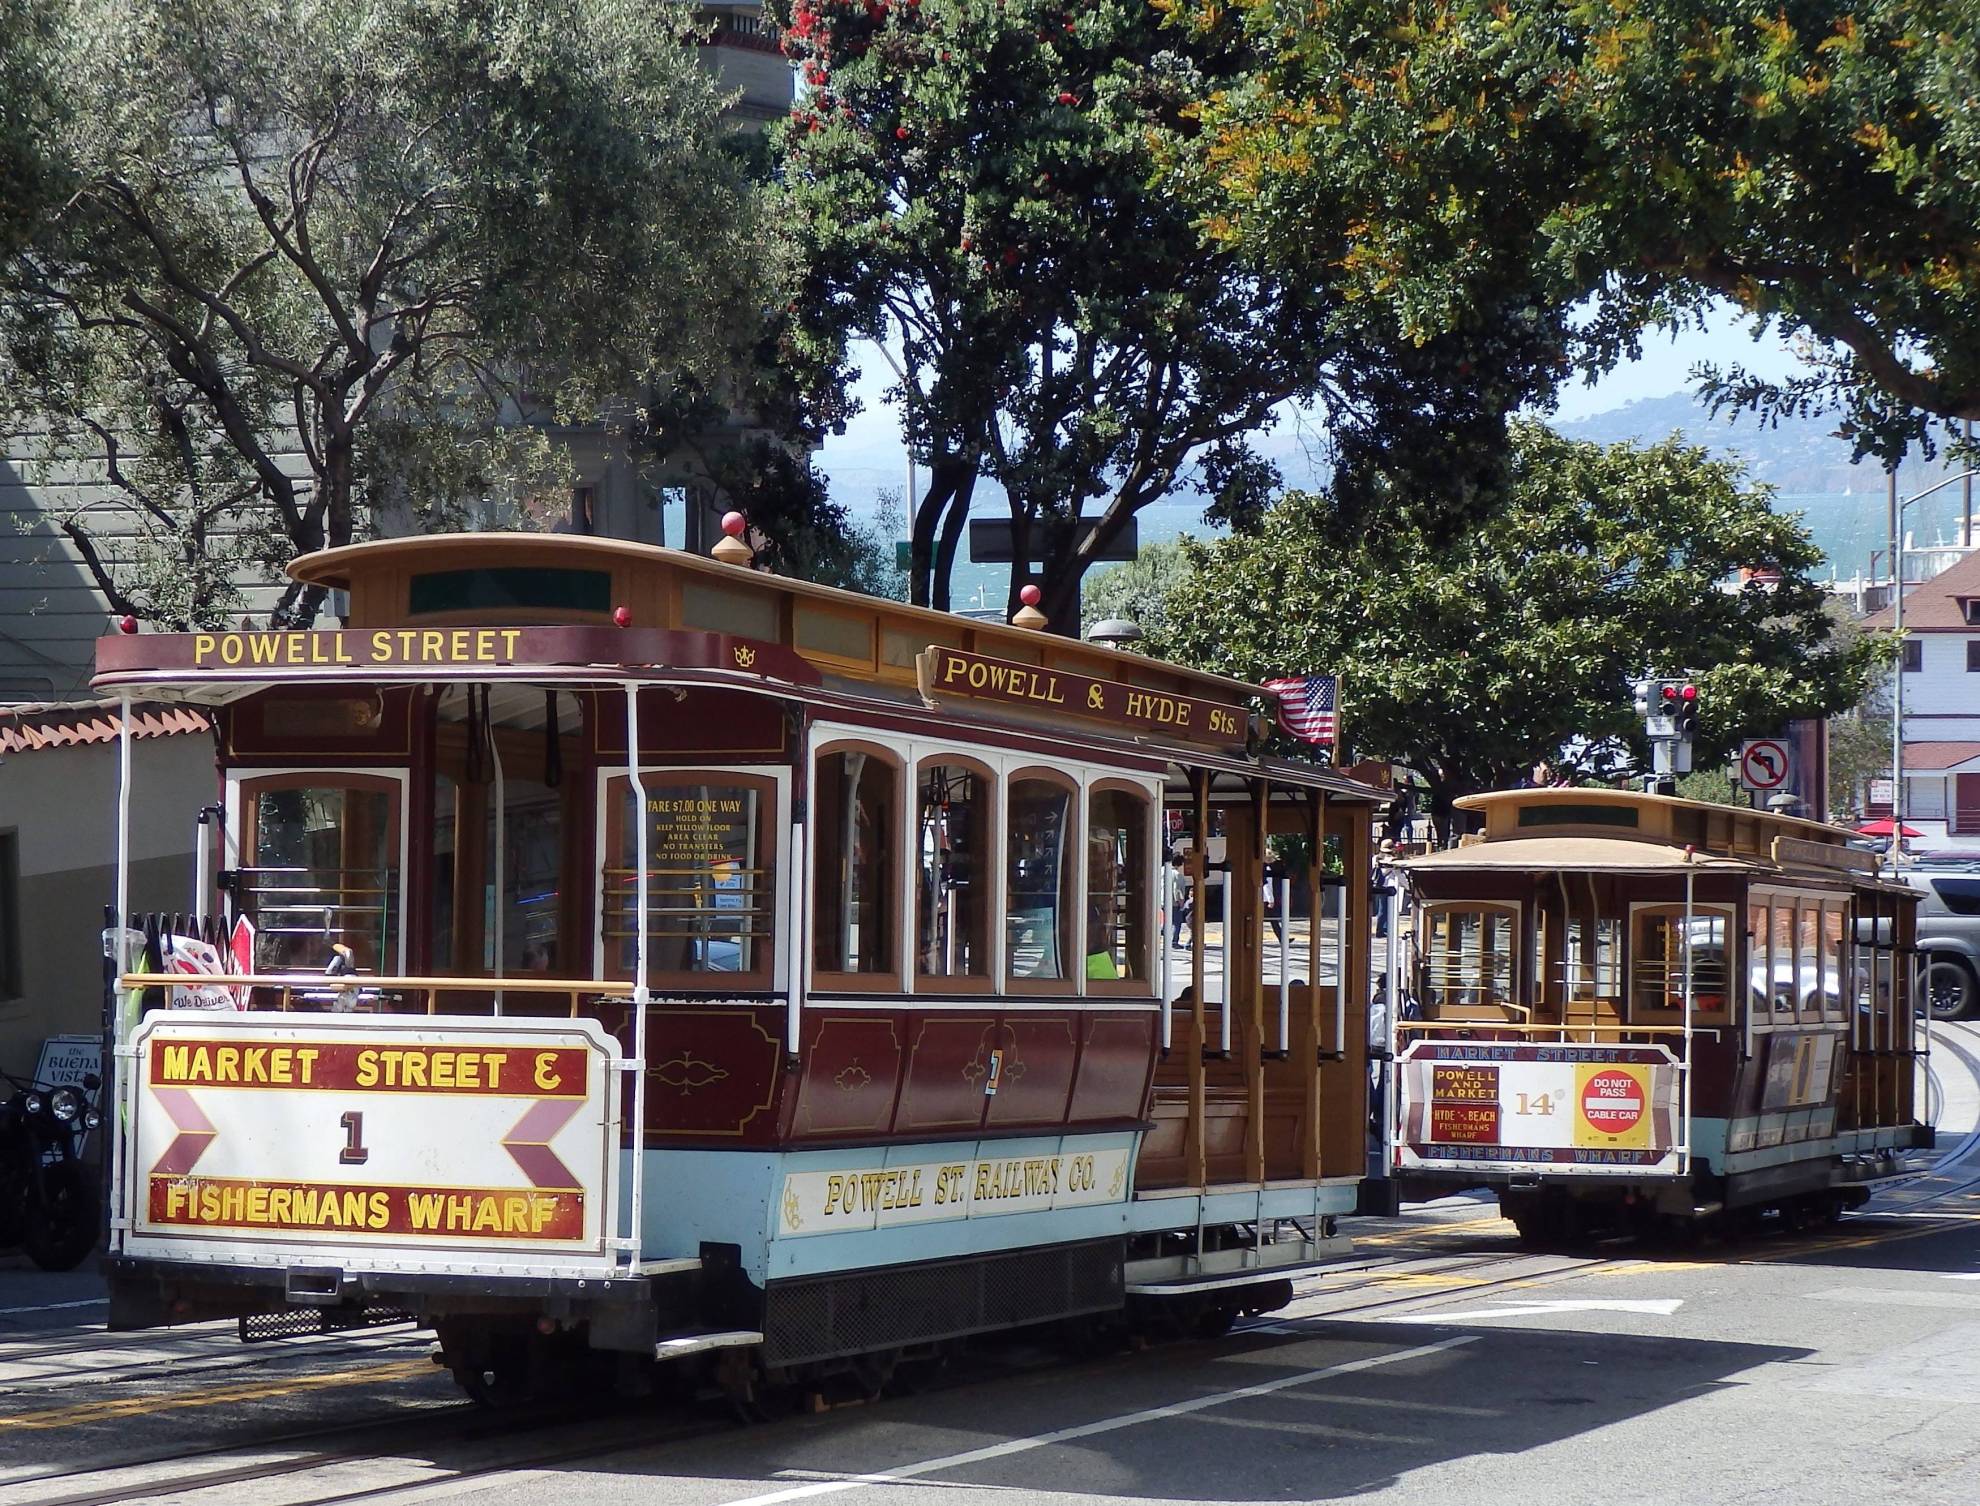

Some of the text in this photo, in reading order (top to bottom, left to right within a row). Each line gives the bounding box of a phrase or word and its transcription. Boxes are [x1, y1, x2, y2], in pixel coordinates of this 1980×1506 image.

[194, 630, 522, 665] POWELL STREET
[943, 657, 1238, 735] POWELL & HYDE Sts.
[647, 799, 741, 813] FARE $7.00 ONE WAY
[707, 853, 732, 861] DRINK
[174, 995, 192, 1008] We
[1436, 1046, 1516, 1060] MARKET
[1536, 1048, 1619, 1062] STREET
[163, 1045, 319, 1083] MARKET
[356, 1049, 508, 1089] STREET
[51, 1070, 88, 1083] VIST
[1436, 1071, 1496, 1081] POWELL
[1594, 1078, 1633, 1088] DO NOT
[1435, 1088, 1497, 1098] MARKET
[1600, 1087, 1626, 1097] PASS
[1516, 1092, 1555, 1116] 14
[1434, 1109, 1456, 1121] HYDE
[1468, 1110, 1496, 1122] BEACH
[1587, 1110, 1638, 1120] CABLE CAR
[1439, 1122, 1490, 1132] FISHERMANS
[339, 1110, 369, 1165] 1
[1450, 1131, 1477, 1139] WHARF
[1428, 1145, 1646, 1164] FISHERMANS WHARF
[824, 1154, 1096, 1216] POWELL ST. RAILWAY CO.
[166, 1183, 557, 1233] FISHERMANS WHARF
